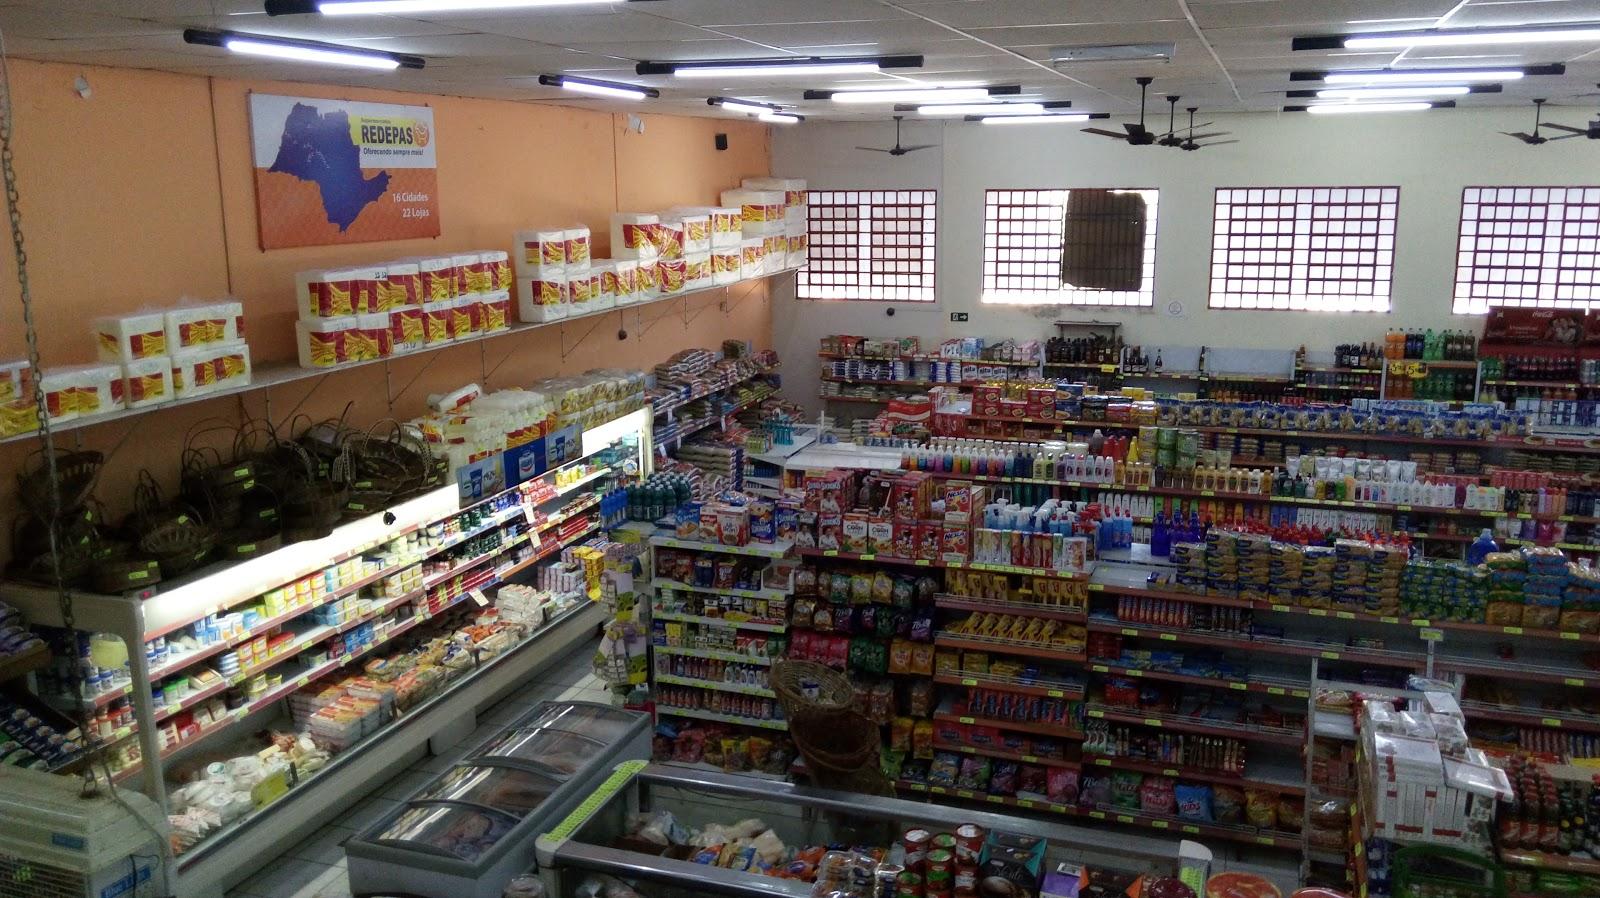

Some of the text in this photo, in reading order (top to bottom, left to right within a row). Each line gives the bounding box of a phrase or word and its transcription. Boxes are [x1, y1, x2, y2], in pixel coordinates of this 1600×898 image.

[361, 125, 413, 144] REDEPAS
[392, 191, 429, 203] 16 Cidades
[402, 207, 430, 219] 22 Lojas
